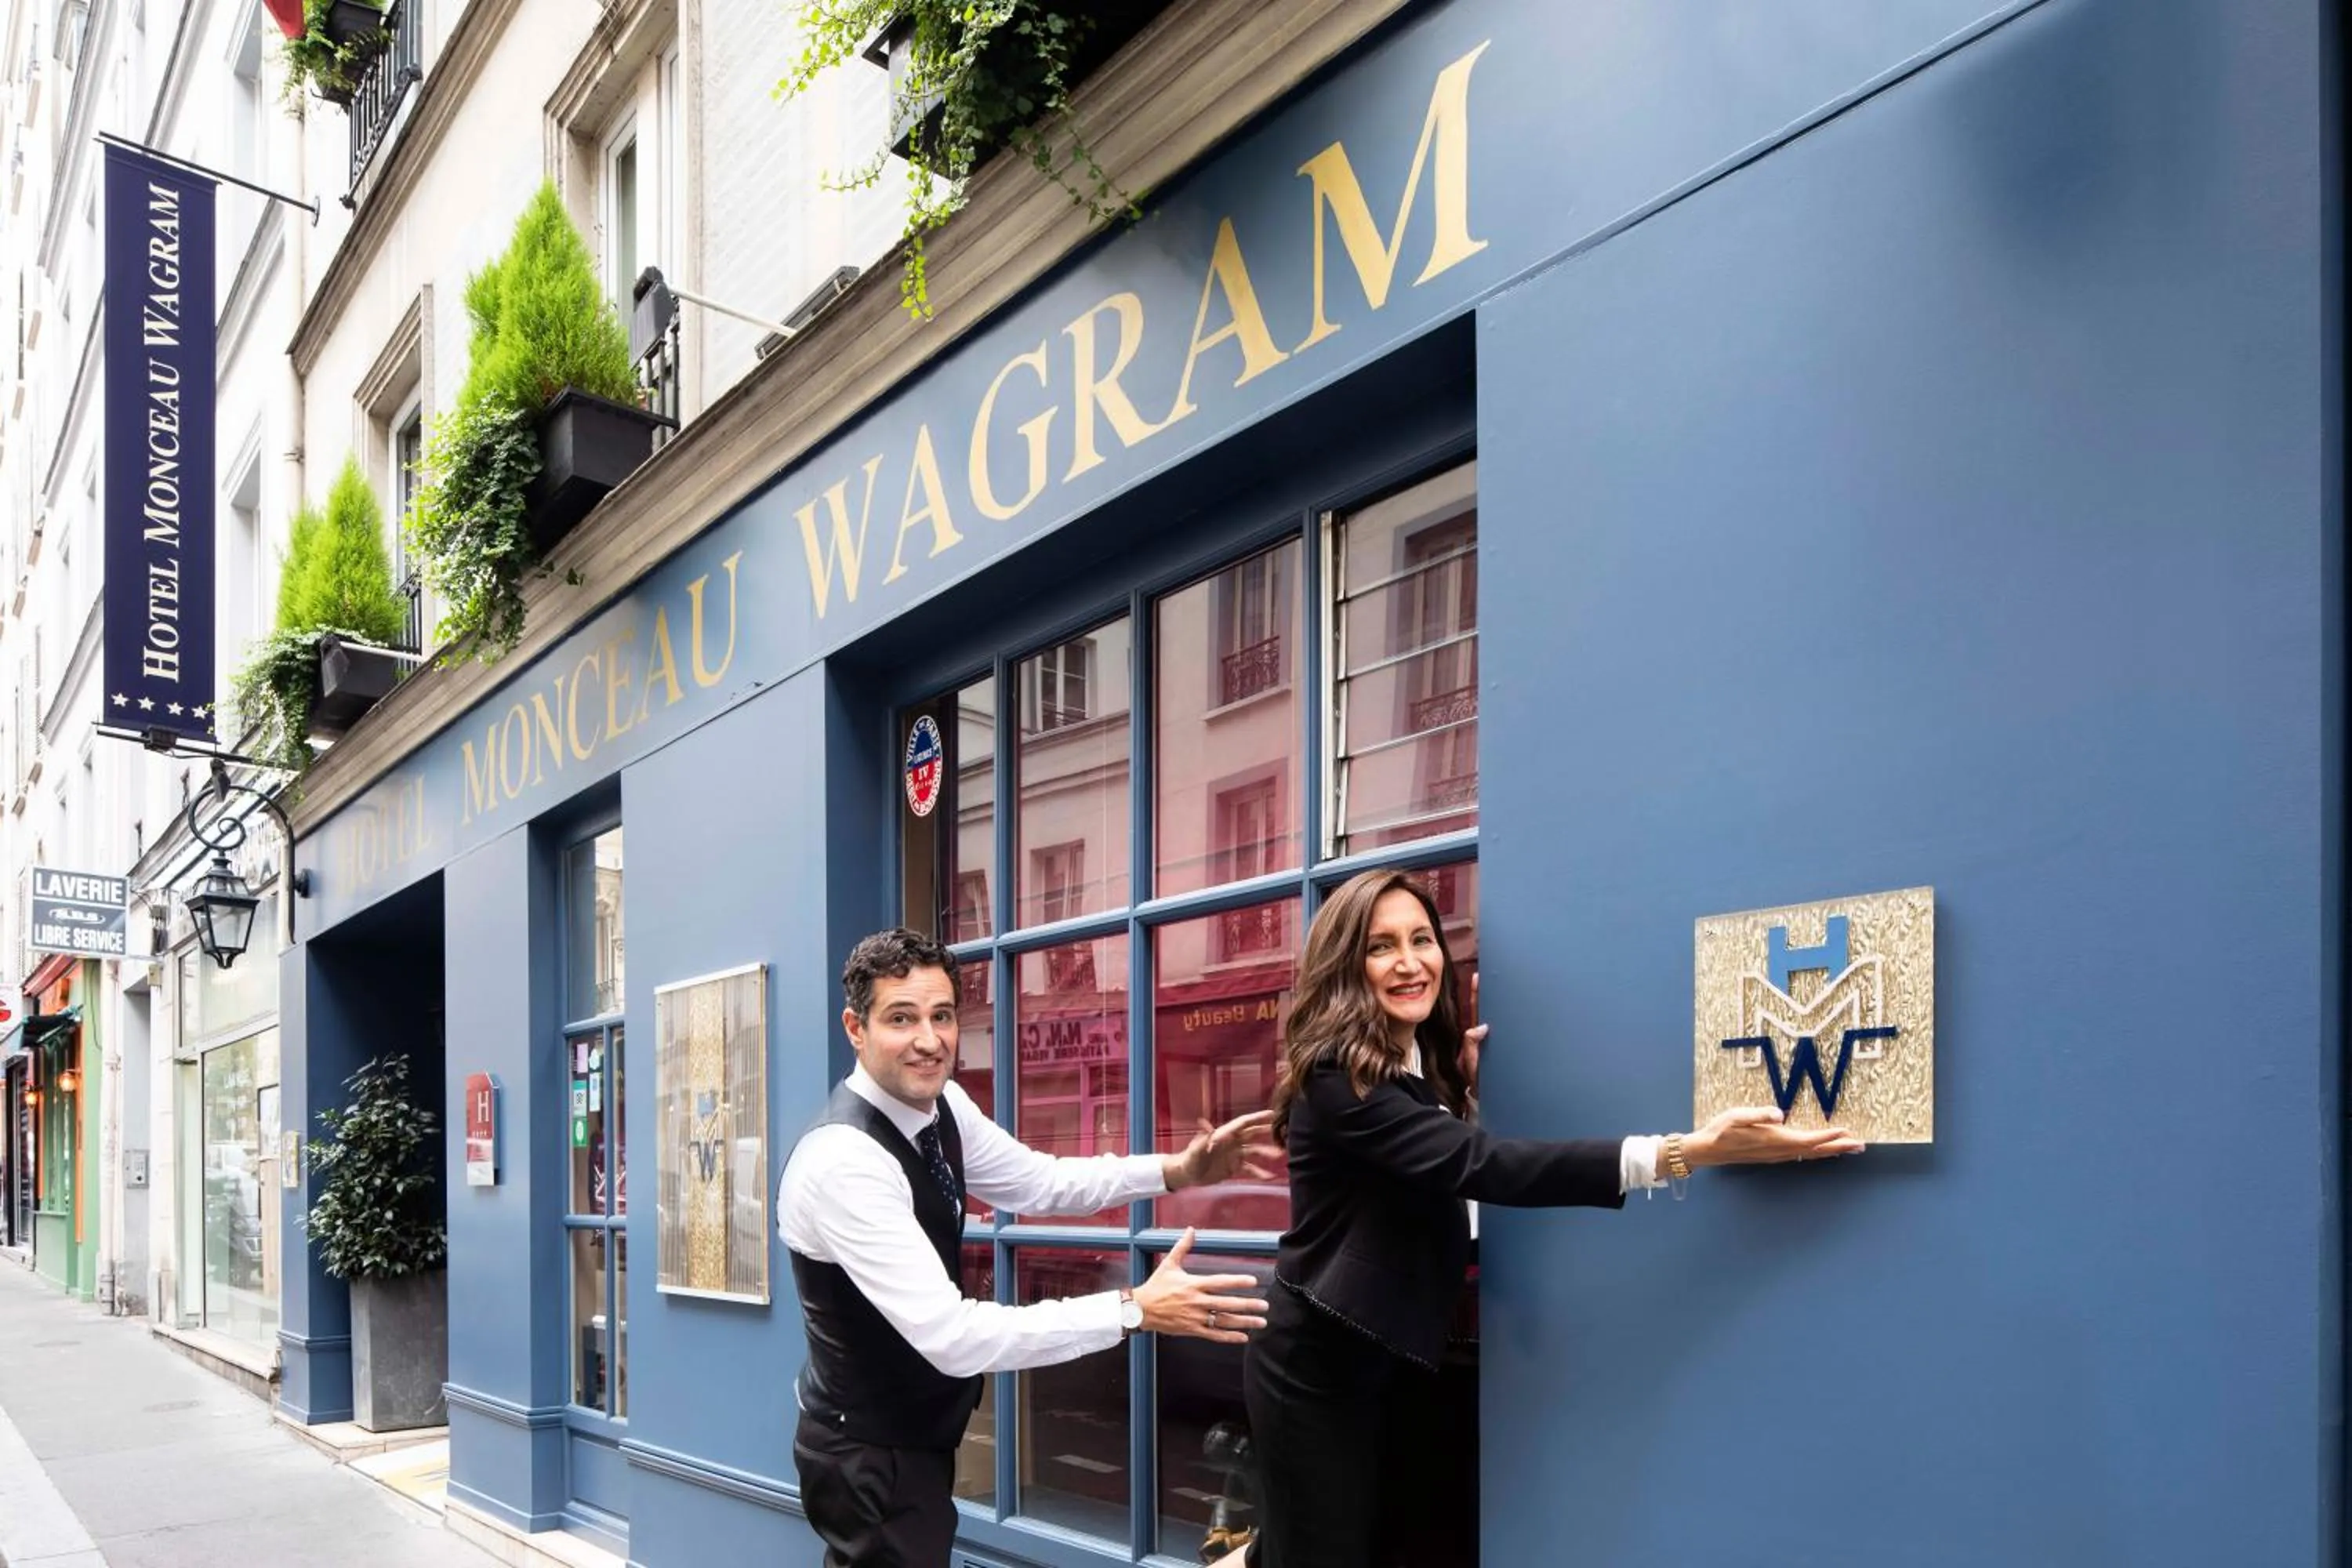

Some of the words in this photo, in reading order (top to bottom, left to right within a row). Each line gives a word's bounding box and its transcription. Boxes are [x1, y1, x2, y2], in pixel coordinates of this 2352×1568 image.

[143, 182, 180, 347] WAGRAM
[143, 358, 180, 548] MONCEAU
[461, 550, 742, 828] MONCEAU
[793, 39, 1490, 619] WAGRAM
[143, 557, 180, 683] HOTEL
[34, 924, 71, 946] LIBRE
[73, 927, 123, 952] SERVICE
[36, 873, 122, 903] LAVERIE
[477, 1091, 489, 1123] H
